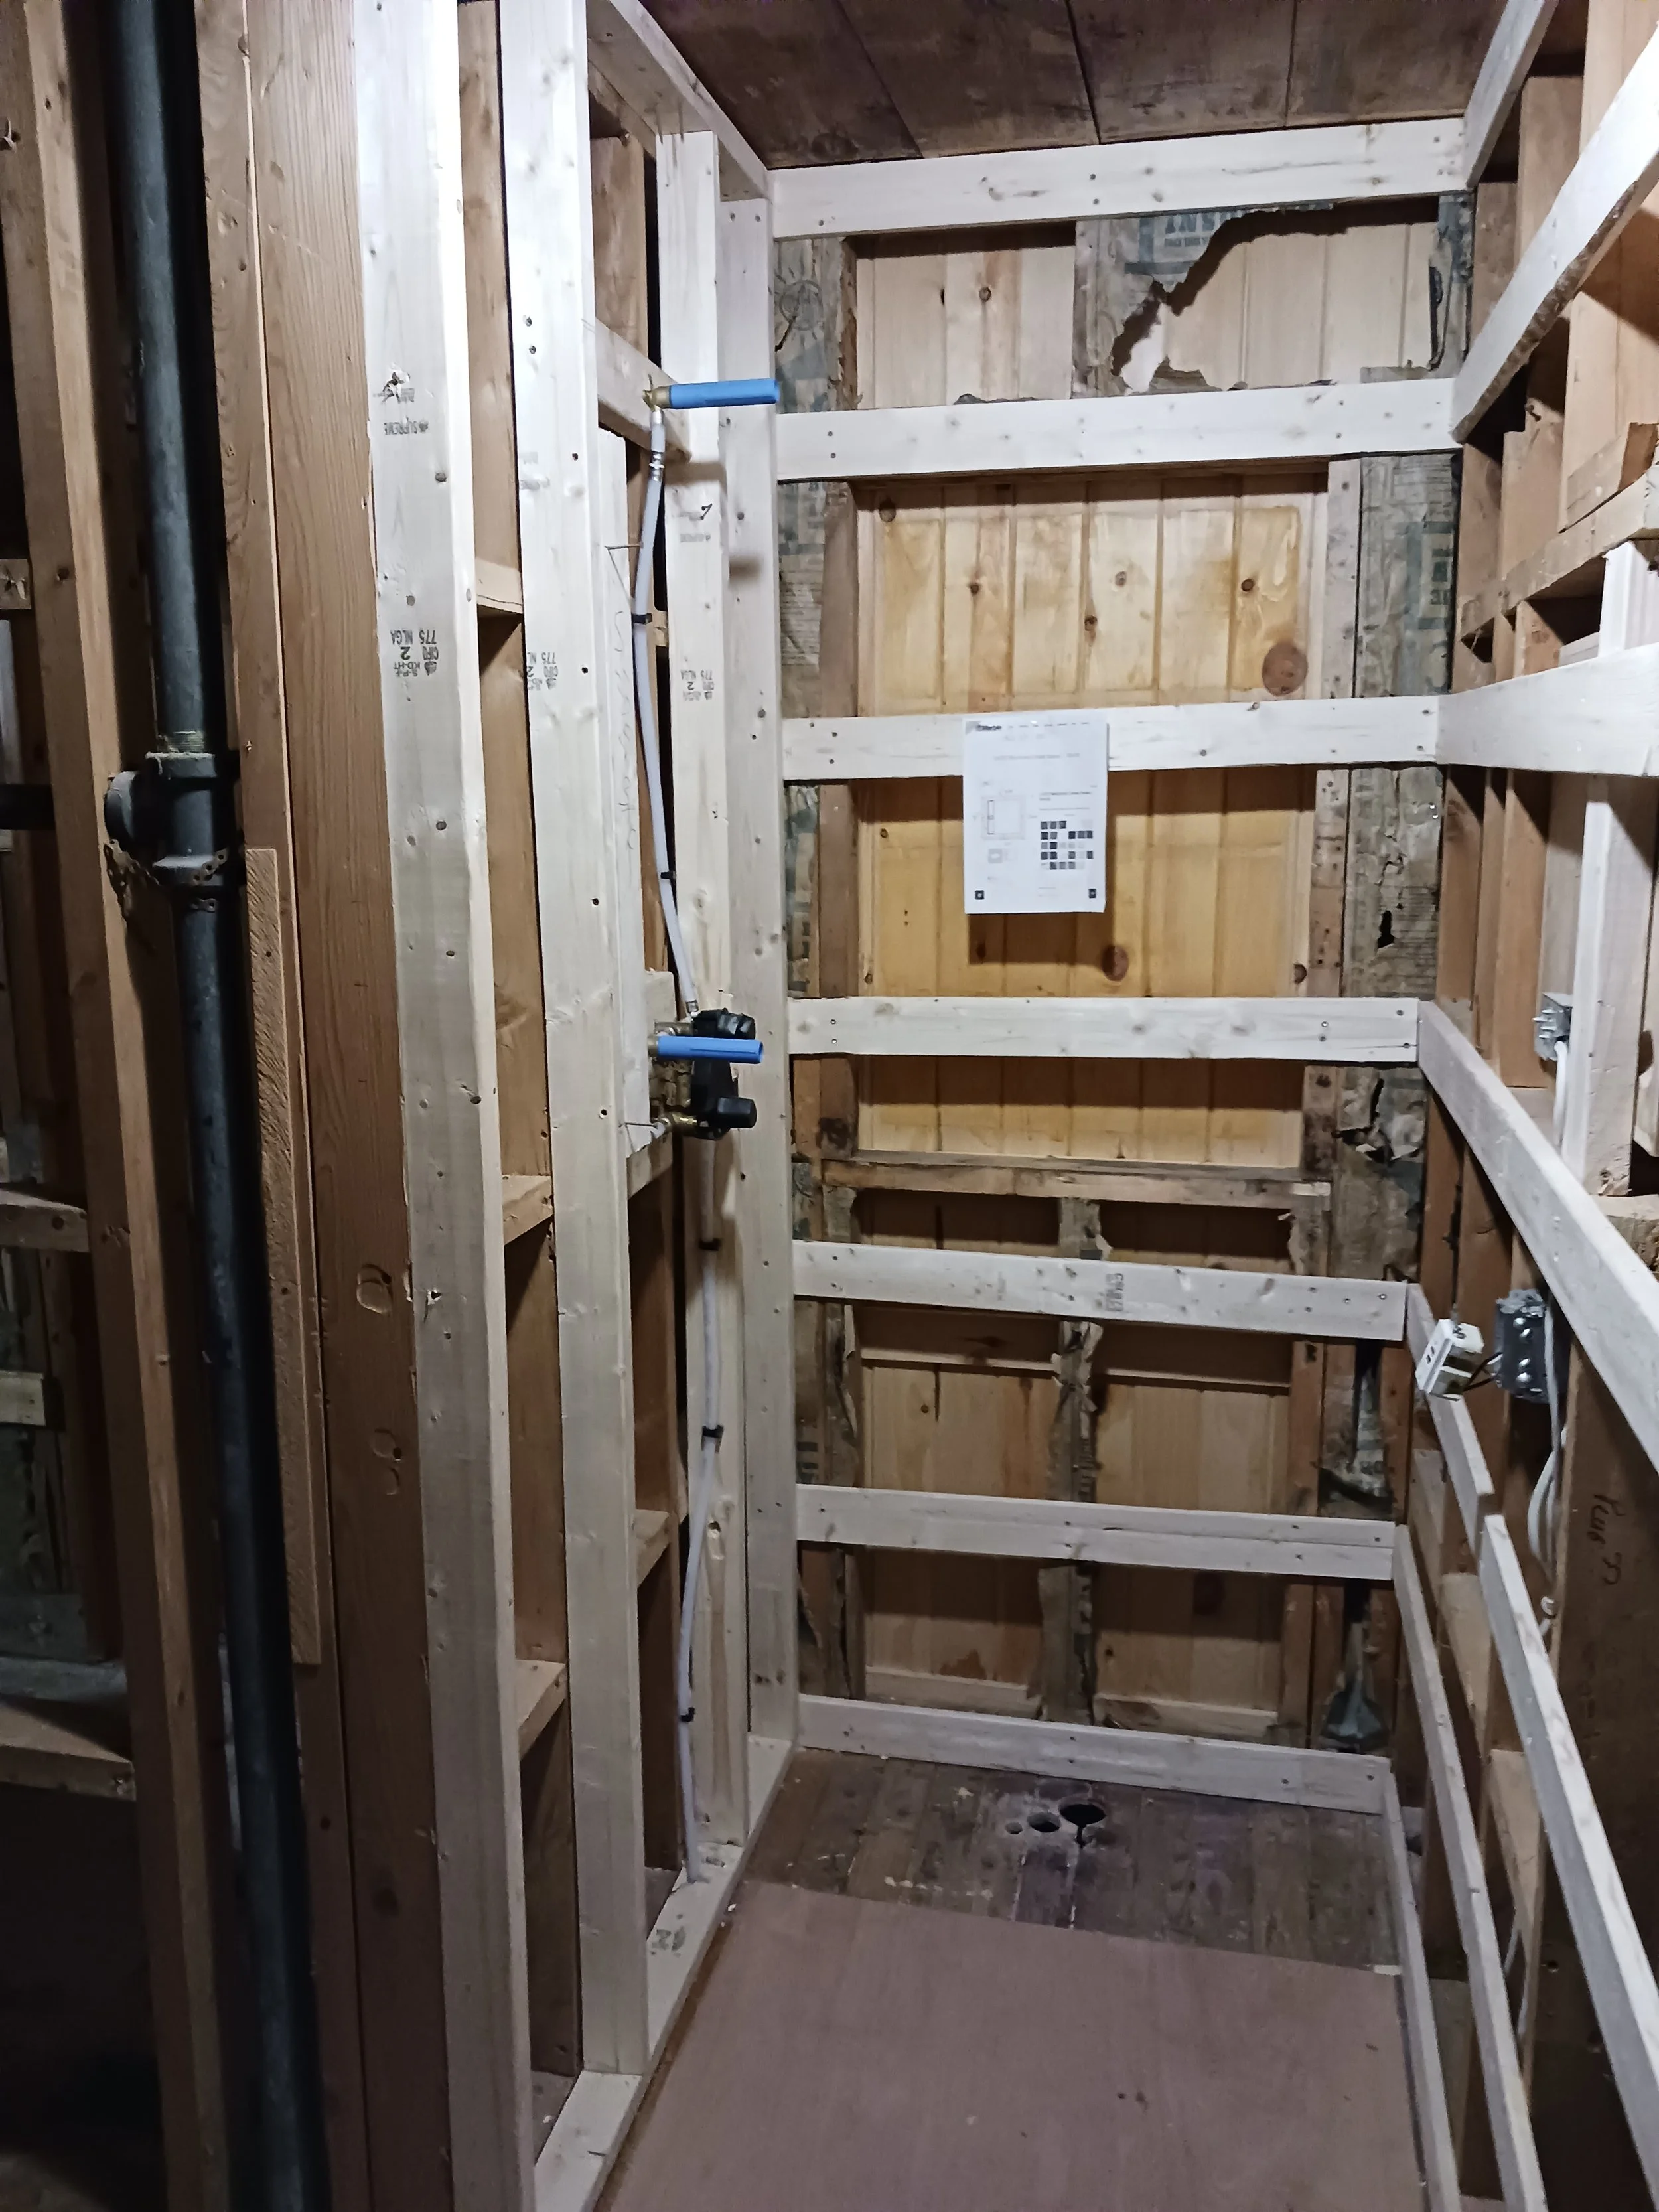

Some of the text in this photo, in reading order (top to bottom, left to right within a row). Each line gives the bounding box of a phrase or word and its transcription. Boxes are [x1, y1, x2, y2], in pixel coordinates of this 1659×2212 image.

[390, 629, 437, 645] 775 NLGA
[400, 646, 411, 660] 2
[541, 652, 556, 664] 775
[394, 661, 421, 670] KD-HT
[687, 681, 695, 690] 2
